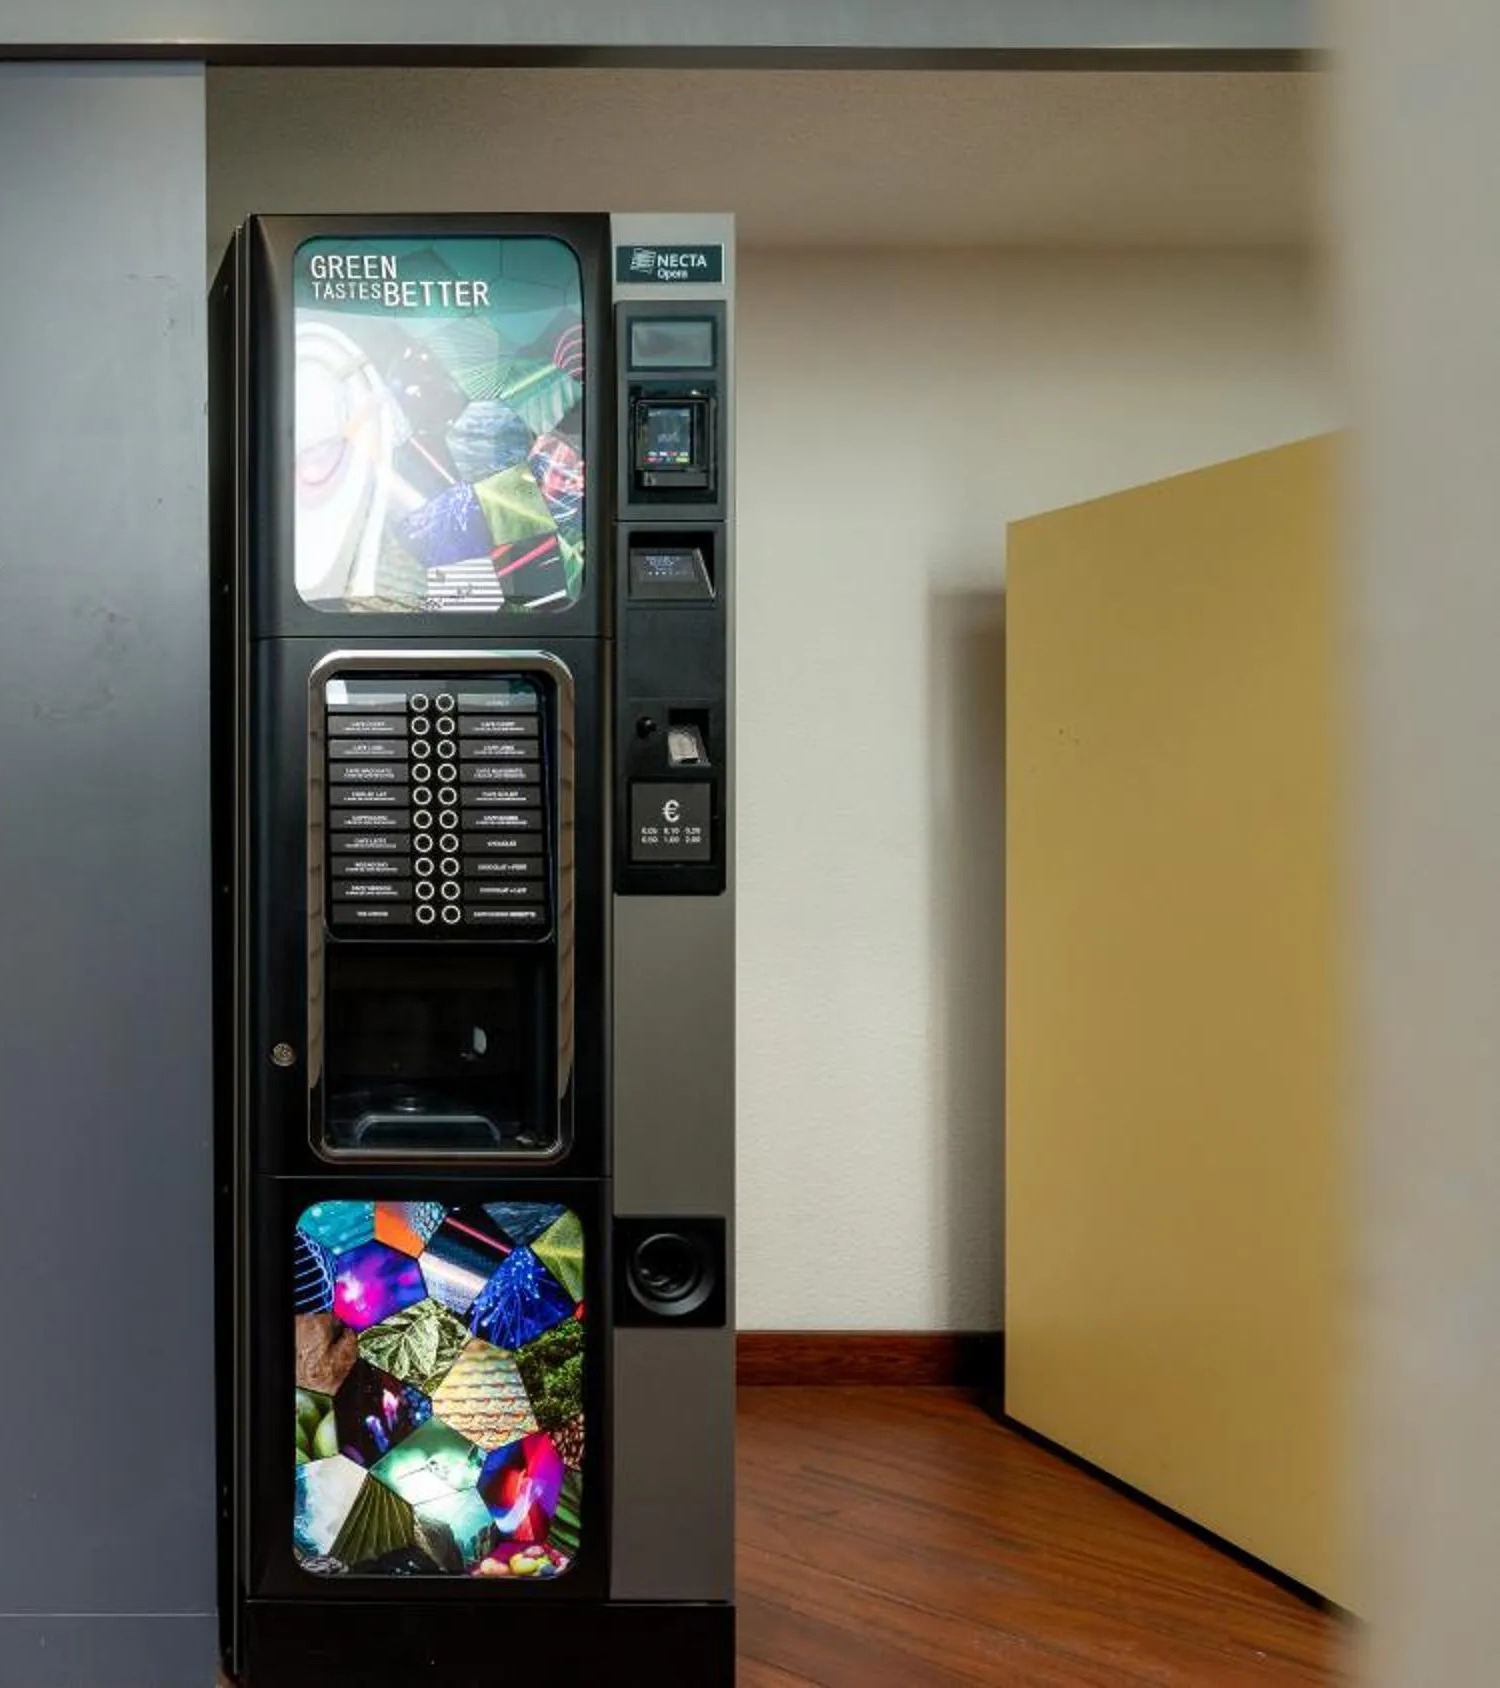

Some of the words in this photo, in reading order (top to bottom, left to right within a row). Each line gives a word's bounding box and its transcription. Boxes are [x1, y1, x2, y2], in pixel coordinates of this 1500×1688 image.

[310, 255, 398, 279] GREEN
[657, 253, 708, 268] NECTA
[311, 281, 381, 300] TASTES
[383, 281, 490, 307] BETTER
[661, 799, 681, 823] €
